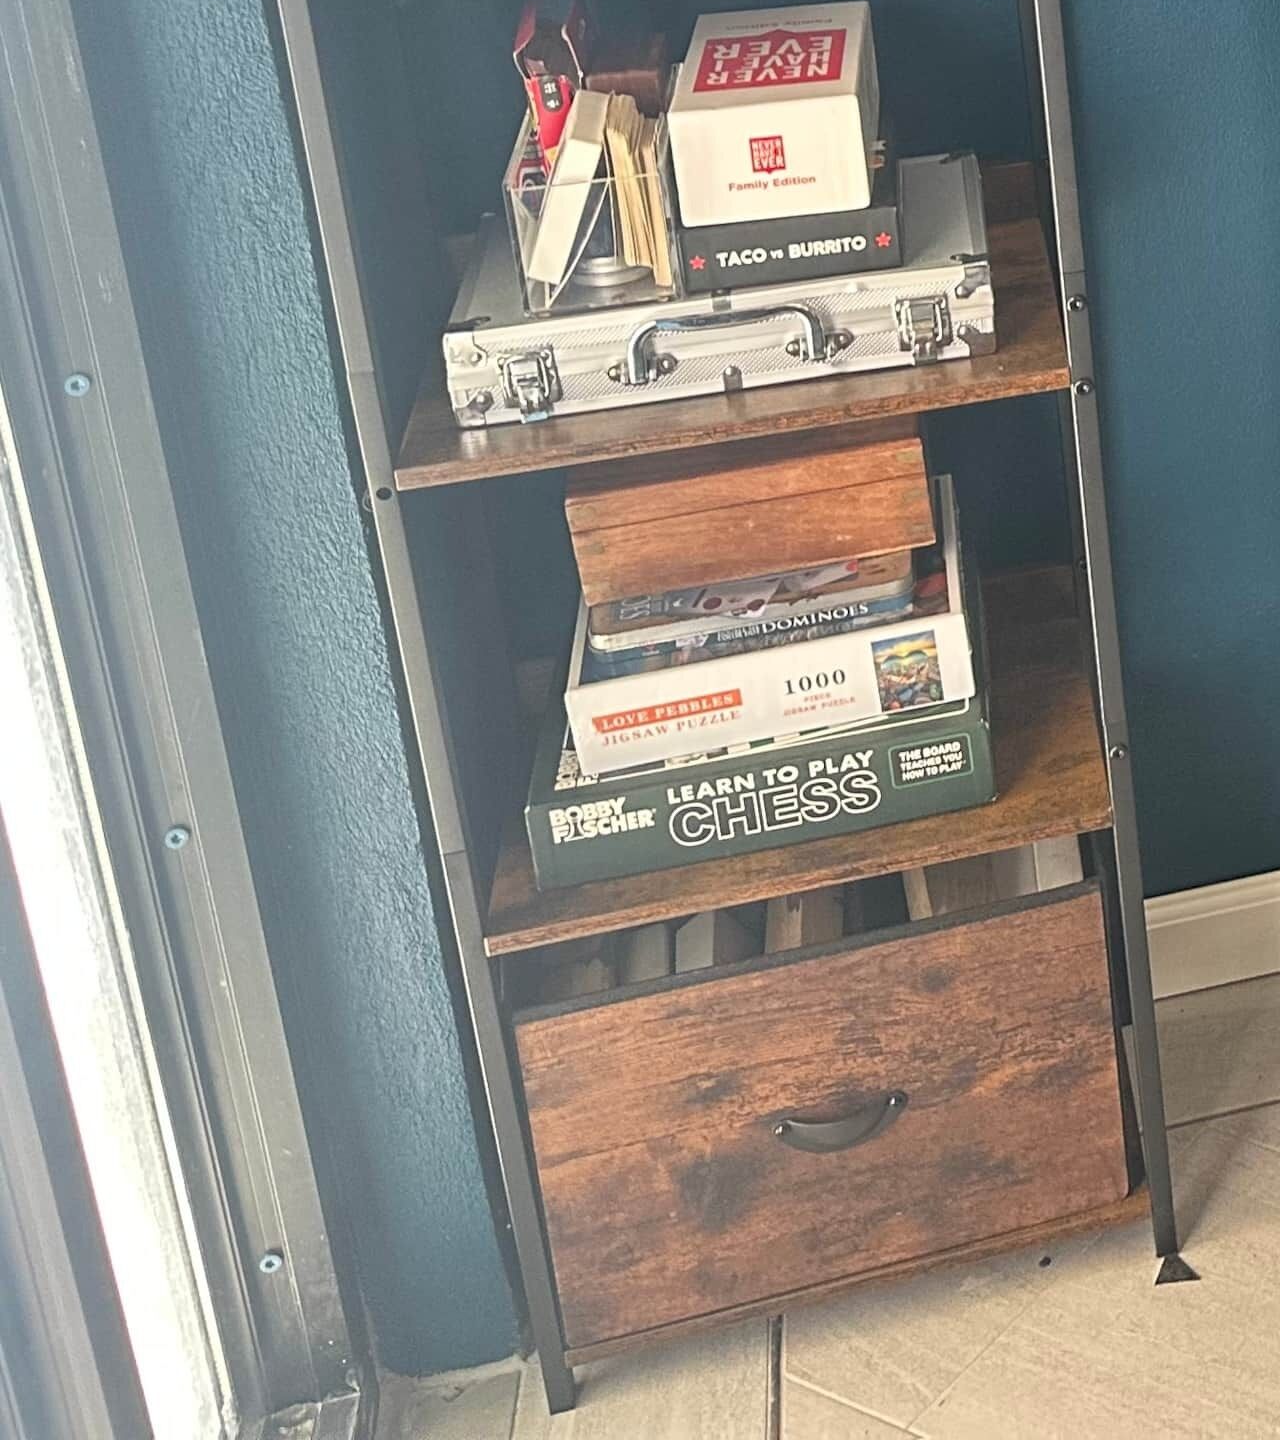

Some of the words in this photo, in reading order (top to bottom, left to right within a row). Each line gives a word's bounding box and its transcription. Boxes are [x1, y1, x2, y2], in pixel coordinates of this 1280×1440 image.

[712, 35, 833, 60] EVER
[743, 49, 830, 71] HAVE
[706, 63, 829, 85] NEVER
[728, 180, 769, 192] Family
[772, 175, 816, 187] Edition
[716, 247, 768, 268] TACO
[788, 235, 867, 259] BURRITO
[761, 603, 869, 634] DOMINOES
[783, 668, 847, 696] 1000
[601, 711, 650, 731] LOVE
[654, 693, 734, 719] PEBBLES
[602, 724, 670, 747] JIGSAW
[676, 710, 741, 732] PUZZLE
[898, 748, 922, 763] THE
[922, 741, 961, 758] BOARD
[943, 751, 963, 763] YOU
[666, 772, 755, 805] LEARN
[762, 765, 799, 786] TO
[808, 750, 874, 777] PLAY
[926, 765, 938, 777] TO
[939, 760, 963, 774] PLAY
[548, 796, 626, 828] BOBBY
[668, 769, 882, 847] CHESS
[552, 809, 656, 845] FISCHER
